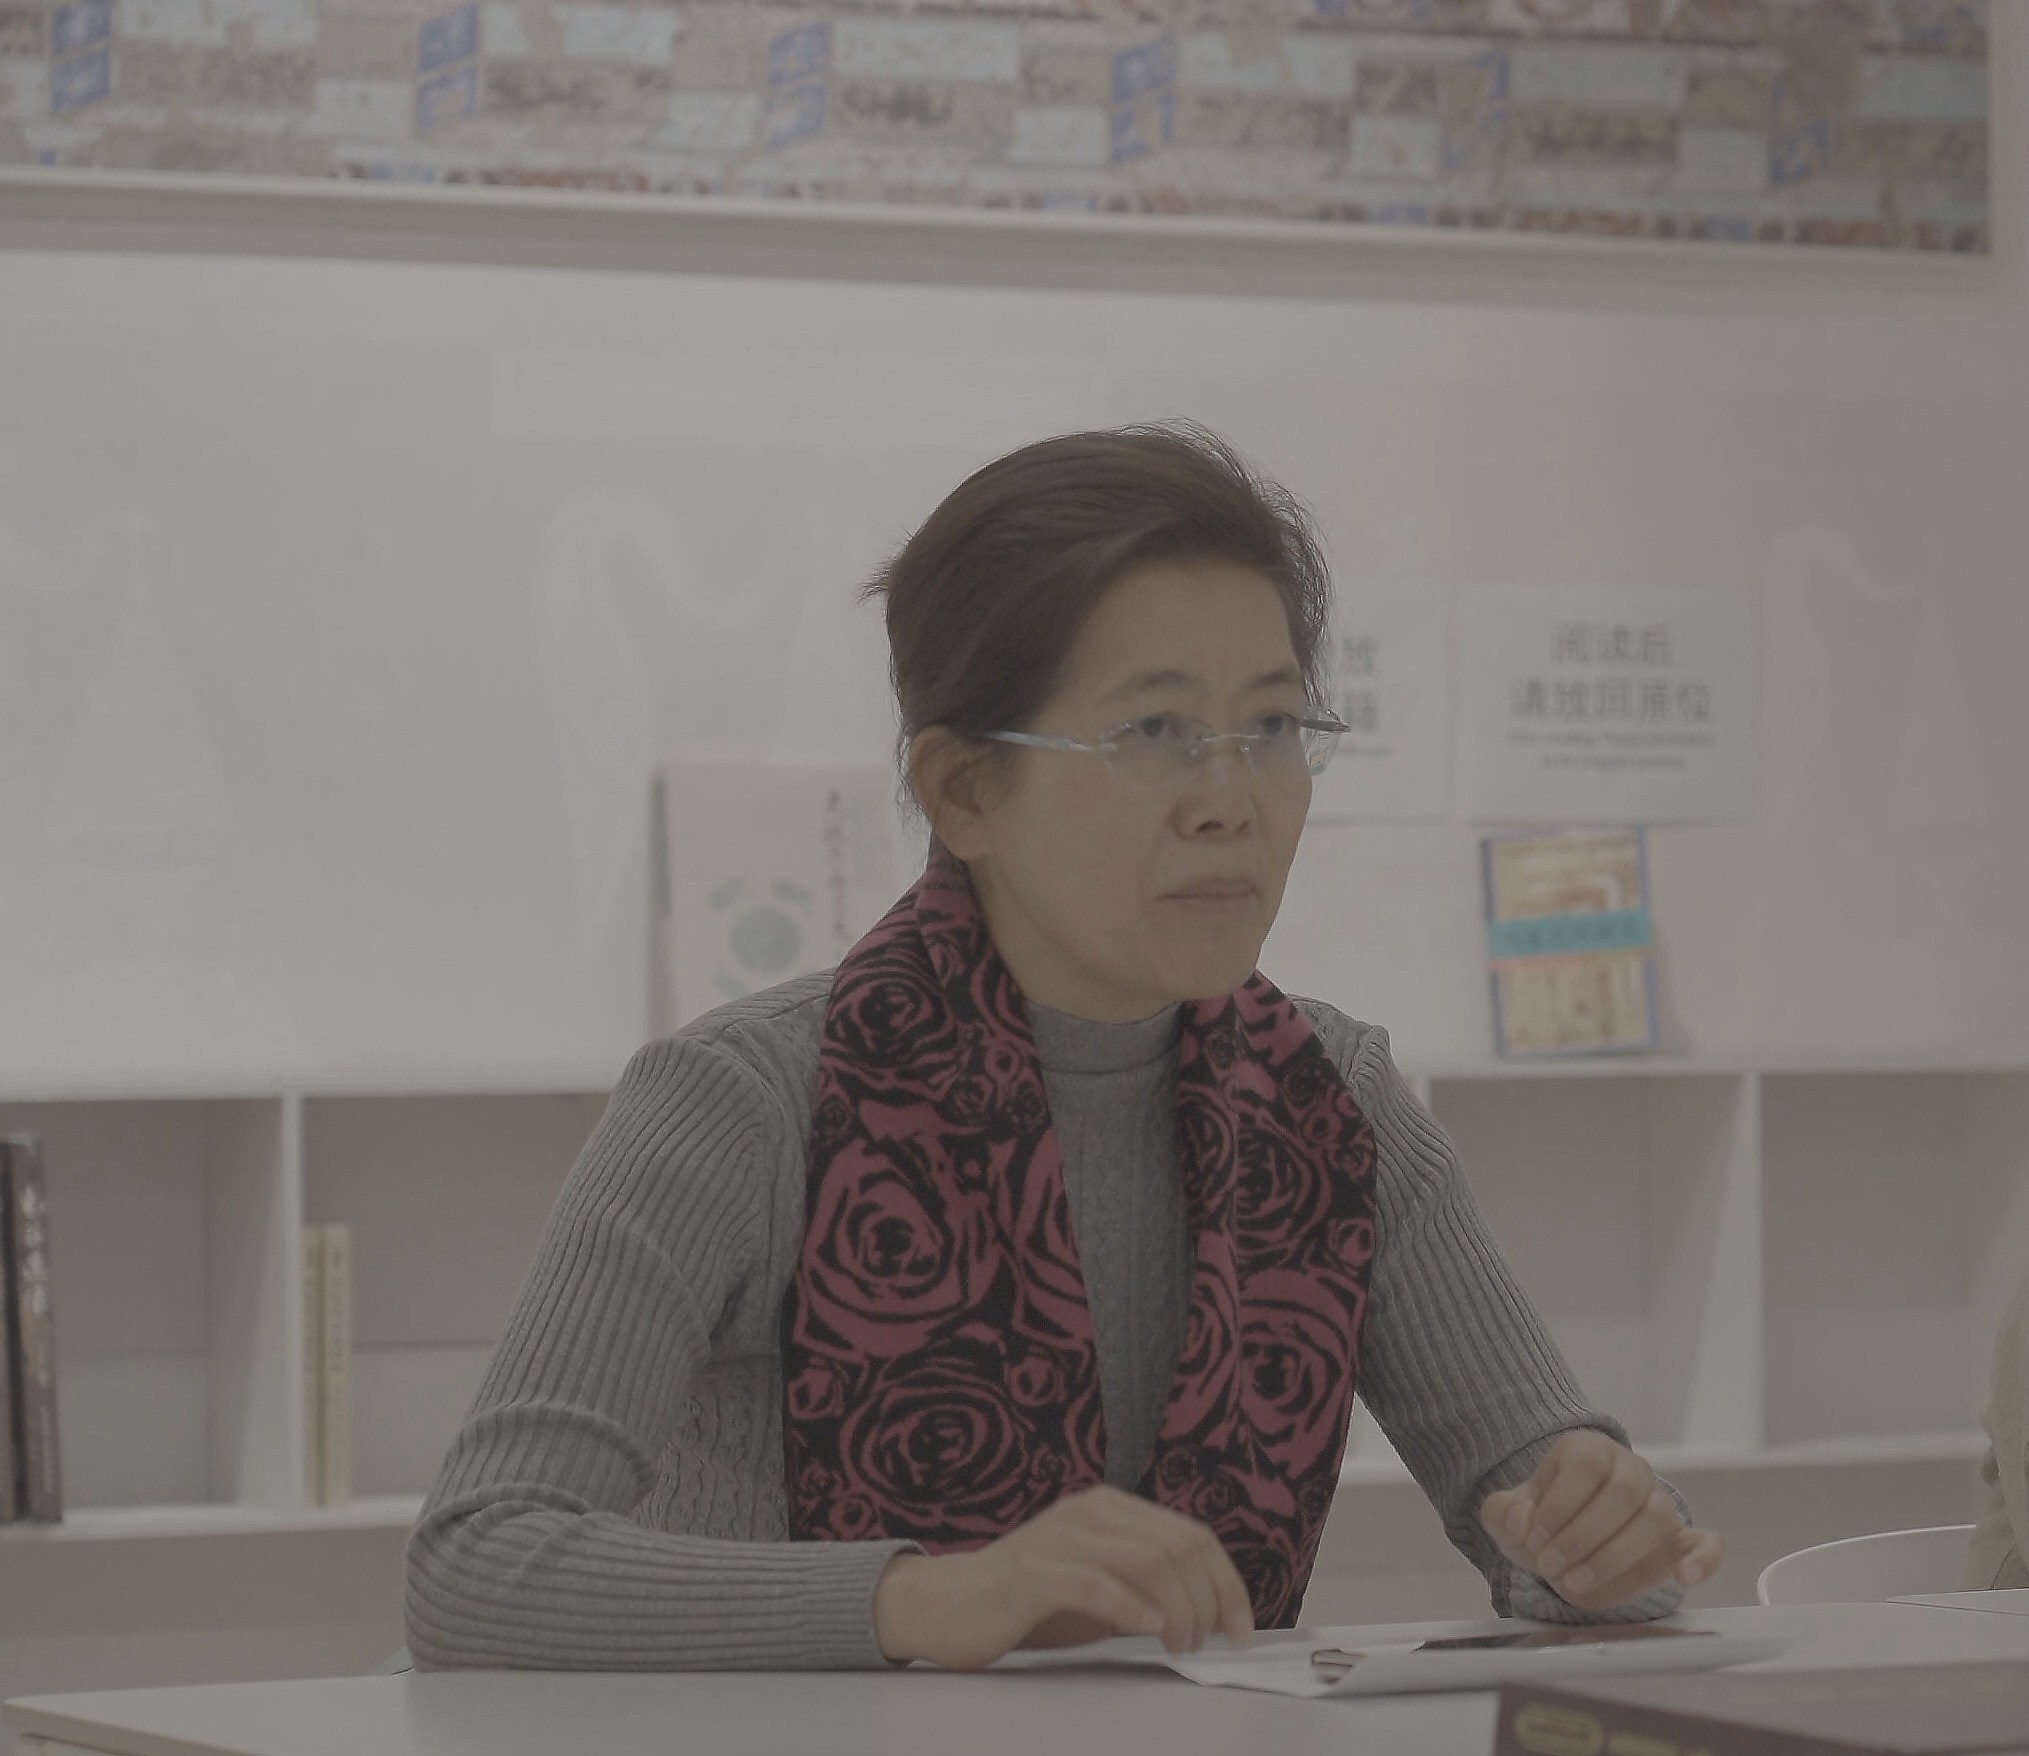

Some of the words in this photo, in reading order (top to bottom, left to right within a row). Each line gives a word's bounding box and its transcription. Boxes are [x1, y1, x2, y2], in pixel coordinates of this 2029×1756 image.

[1552, 621, 1674, 664] 阅读后
[1510, 677, 1713, 721] 请放回原位
